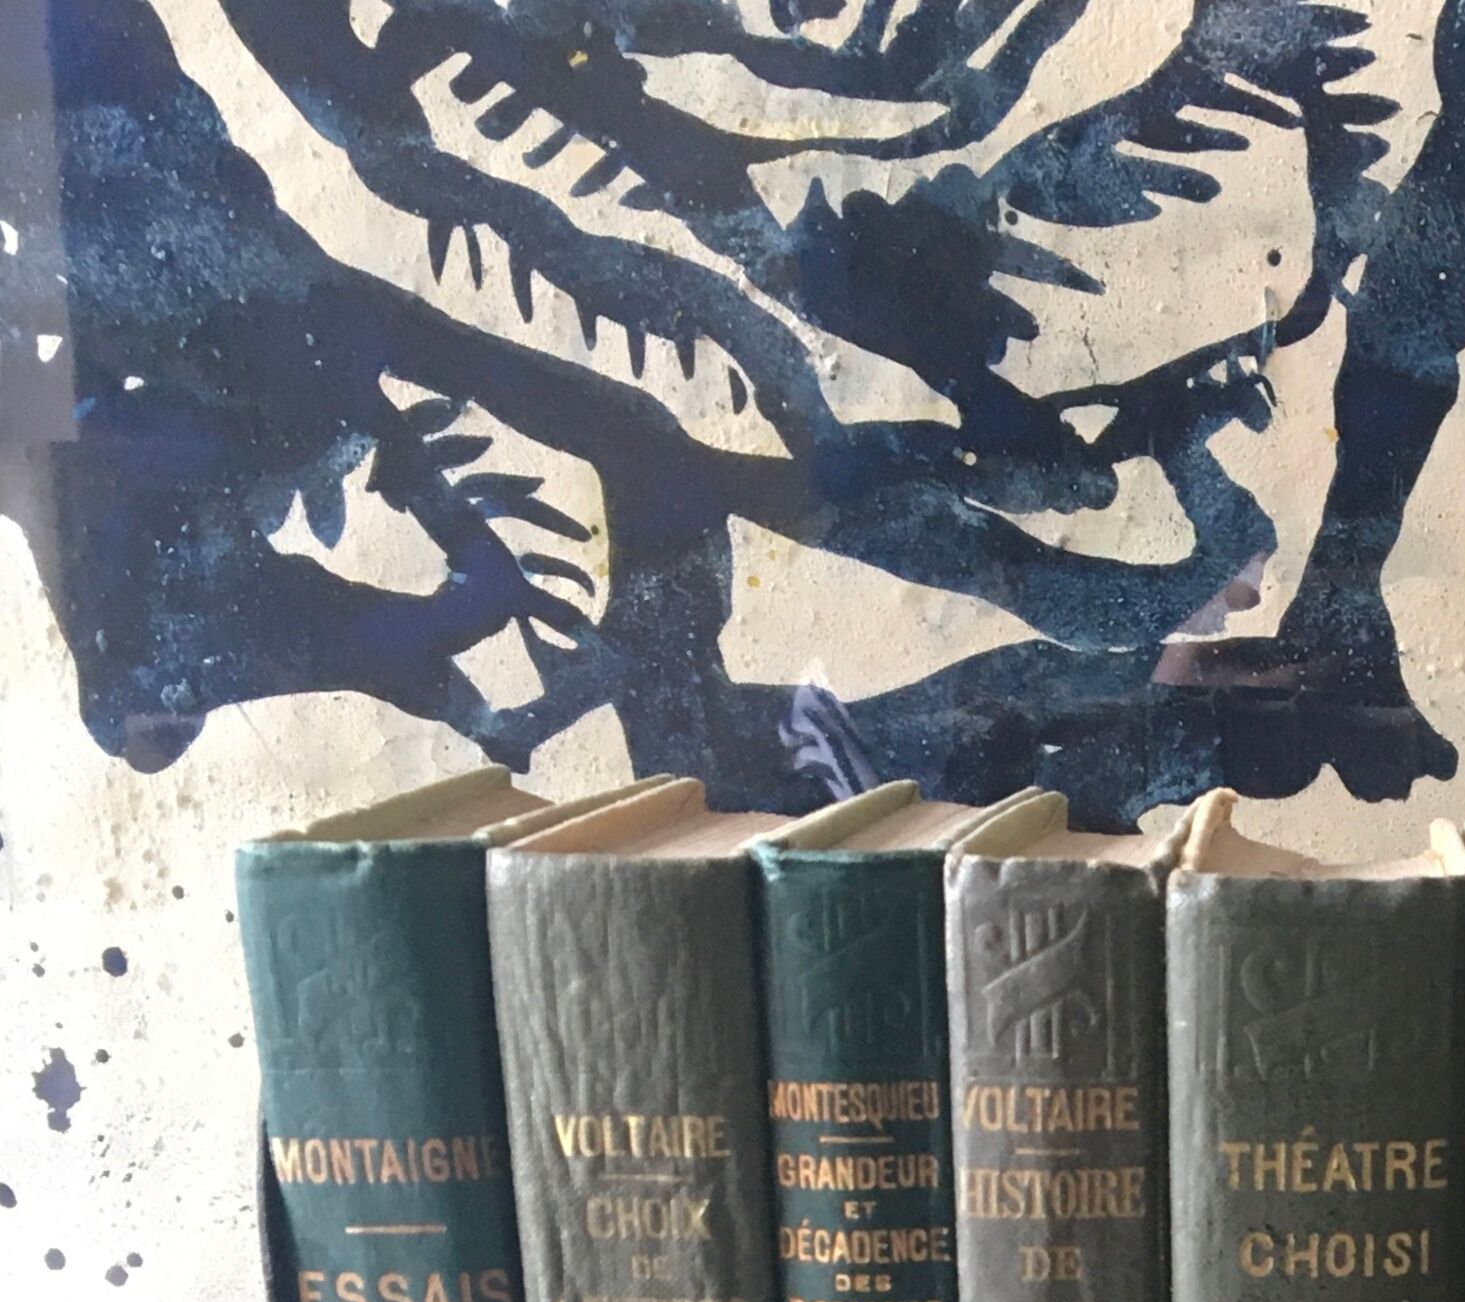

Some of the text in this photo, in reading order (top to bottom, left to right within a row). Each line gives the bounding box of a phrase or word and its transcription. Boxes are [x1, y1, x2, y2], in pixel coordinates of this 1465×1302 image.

[769, 1080, 940, 1130] MONTESQUIEU
[963, 1086, 1140, 1133] VOLTAIRE
[553, 1114, 731, 1159] VOLTAIRE
[777, 1153, 939, 1190] GRANDEUR
[955, 1167, 1146, 1220] HISTOIRE
[585, 1195, 712, 1241] CHOIX
[844, 1201, 876, 1220] ET
[780, 1220, 950, 1264] DÉCADENCE
[1019, 1246, 1083, 1282] DE
[1239, 1229, 1430, 1277] CHOISI
[631, 1255, 672, 1280] DE
[835, 1273, 892, 1293] DES
